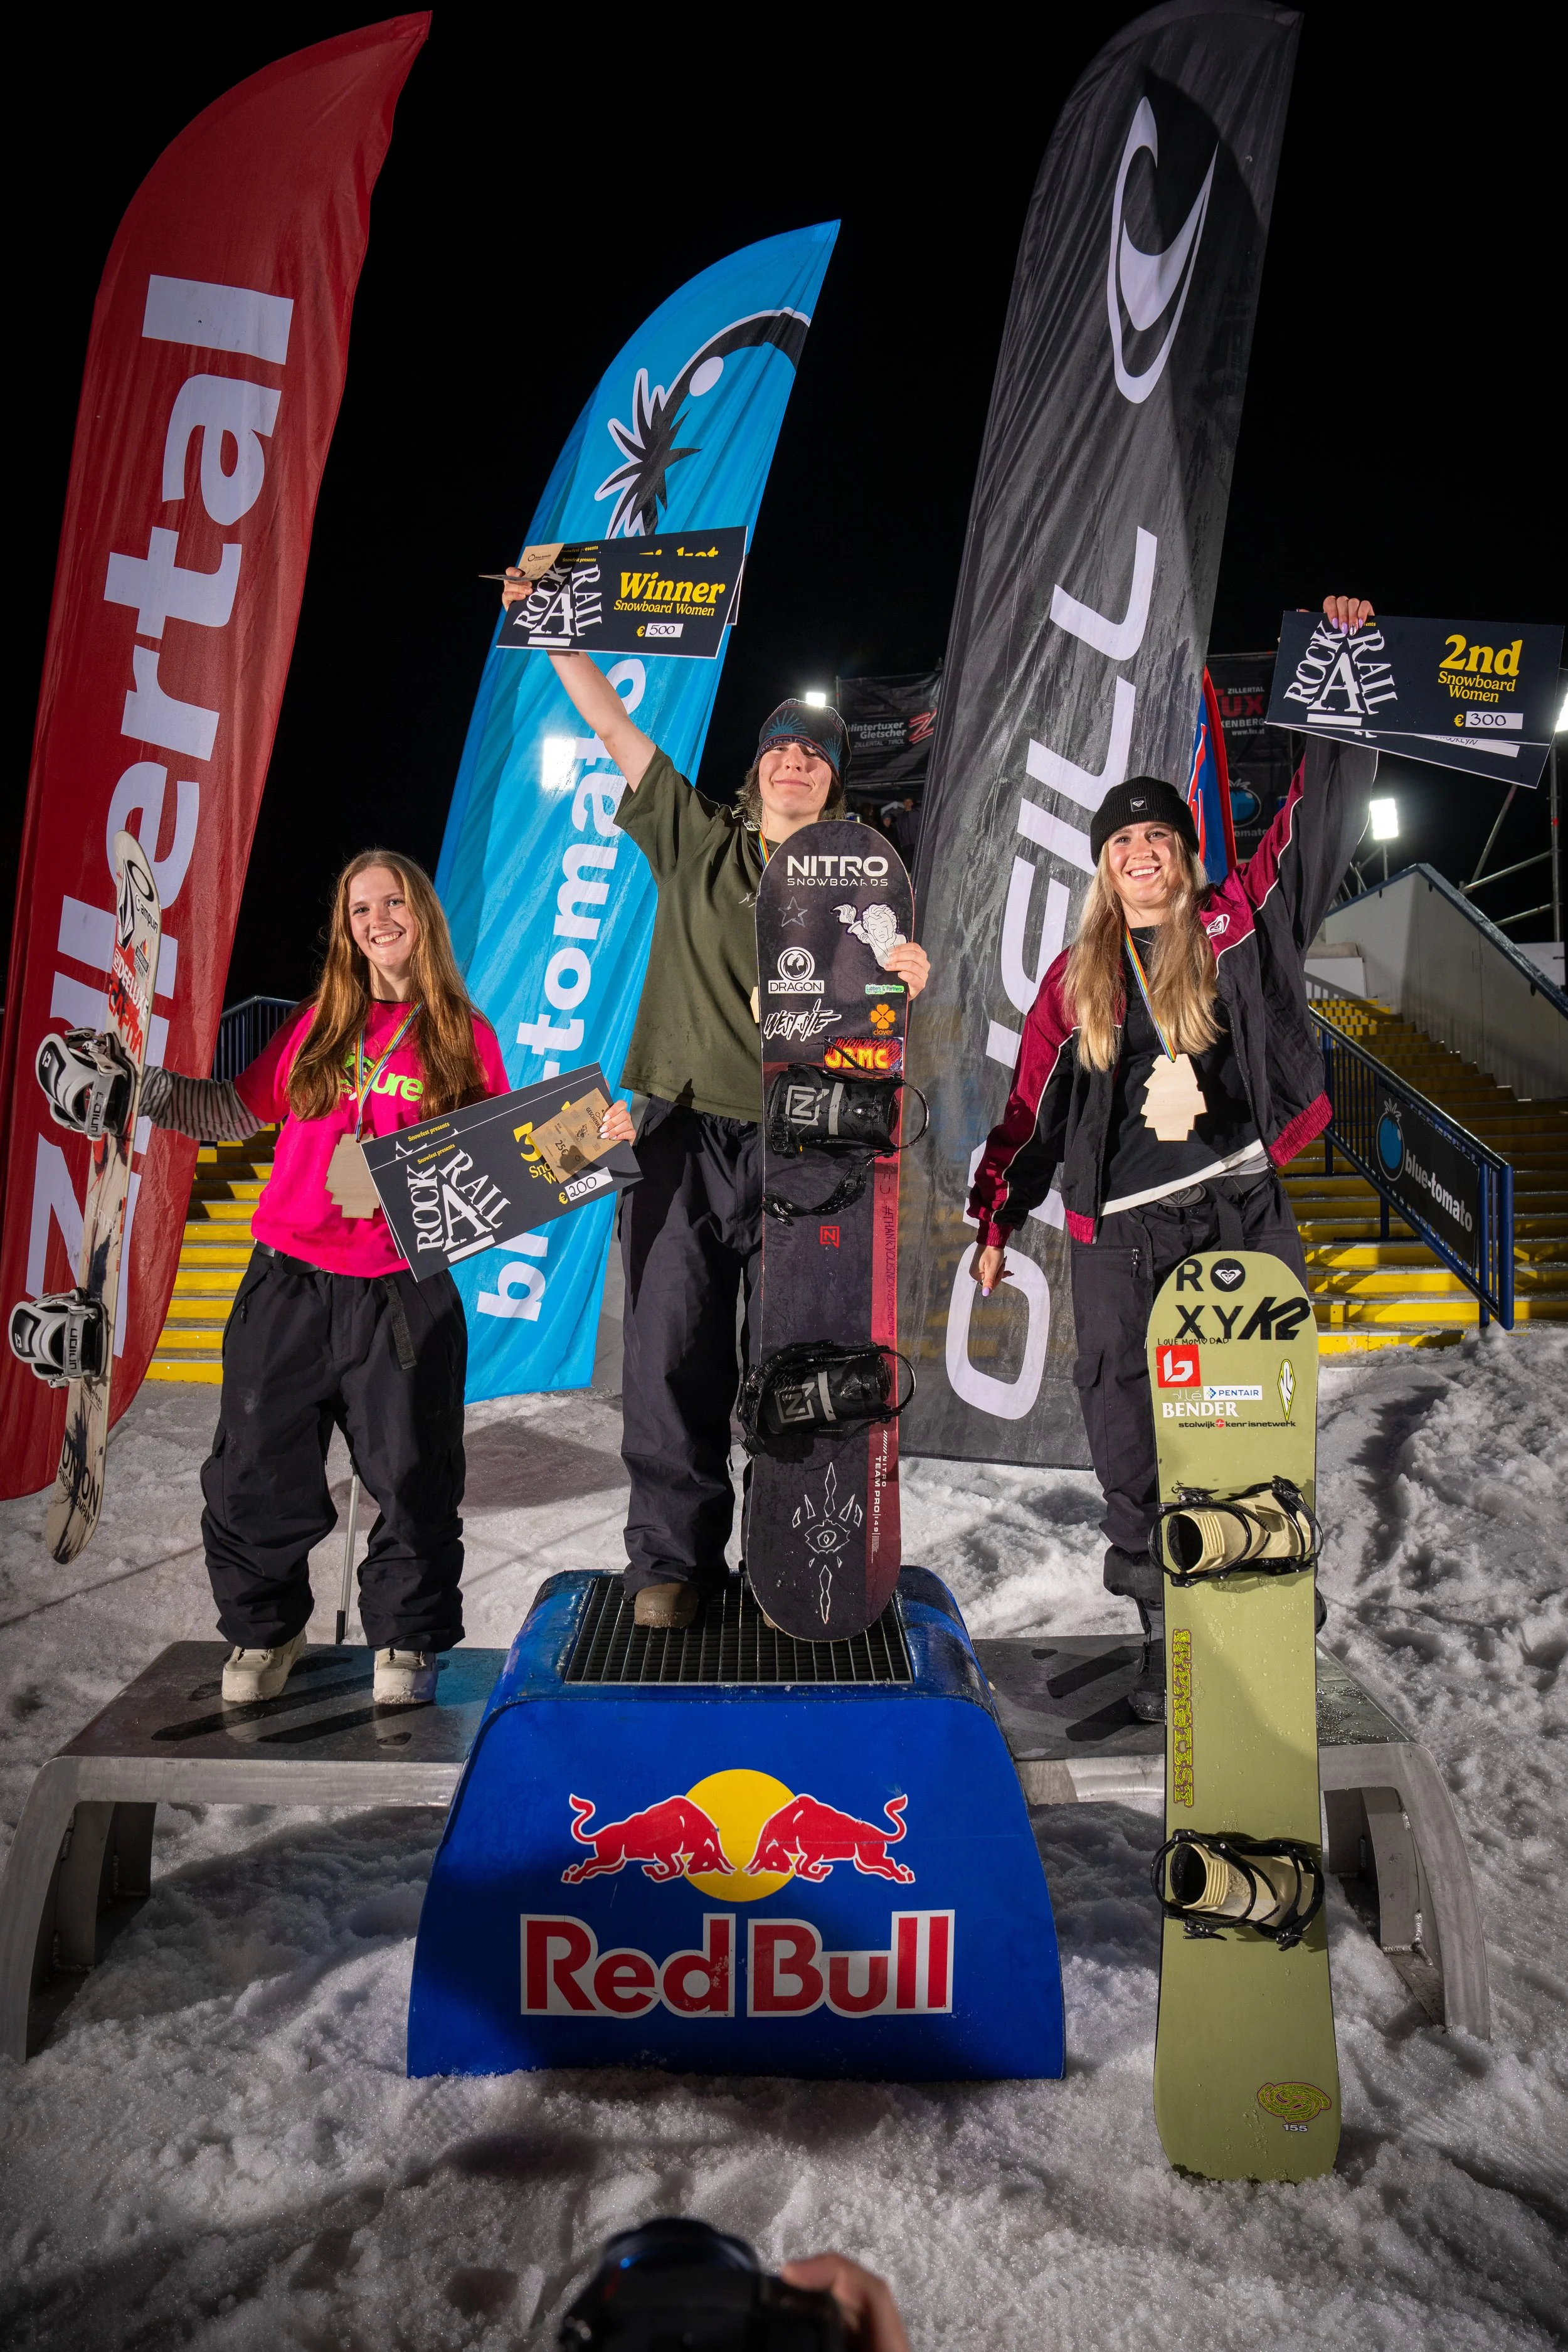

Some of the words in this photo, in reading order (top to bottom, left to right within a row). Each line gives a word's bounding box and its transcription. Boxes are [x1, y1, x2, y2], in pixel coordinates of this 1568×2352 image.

[513, 563, 572, 628] ROCK
[571, 564, 602, 637] RAIL
[620, 571, 726, 604] Winner
[529, 585, 574, 635] A
[614, 600, 673, 614] Snowboard
[676, 603, 715, 617] Women
[637, 626, 645, 637] €
[649, 624, 675, 636] 500
[1283, 620, 1345, 704] ROCK
[1439, 634, 1523, 677] 2nd
[1306, 652, 1365, 714] A
[1347, 630, 1397, 715] RAIL
[1438, 671, 1516, 692] Snowboard
[1449, 684, 1500, 703] Women
[848, 722, 904, 732] Hintertuxer
[860, 729, 907, 739] Gletscher
[1454, 714, 1463, 727] €
[1470, 712, 1507, 726] 300
[26, 274, 294, 1358] Zllertal
[787, 856, 888, 877] NITRO
[787, 878, 888, 886] SNOWBOARDS
[117, 959, 149, 1022] DEELUXE
[770, 982, 822, 992] DRAGON
[408, 1130, 430, 1142] Snowfest
[430, 1121, 450, 1135] presents
[417, 1152, 437, 1165] Snowfest
[437, 1143, 455, 1157] presents
[438, 1149, 511, 1229] RAIL
[559, 1192, 568, 1204] €
[570, 1177, 597, 1199] 200
[1405, 1149, 1473, 1233] blue-tomato
[406, 1164, 445, 1253] ROCK
[442, 1184, 495, 1253] A
[1237, 1296, 1311, 1340] K2
[1162, 1402, 1239, 1418] BENDER
[1179, 1421, 1216, 1429] stolwijk
[61, 1428, 100, 1517] UNON
[76, 1495, 94, 1528] OMPANY
[521, 1913, 736, 2018] Red
[748, 1910, 955, 2018] Bull
[1282, 2123, 1308, 2132] 155
